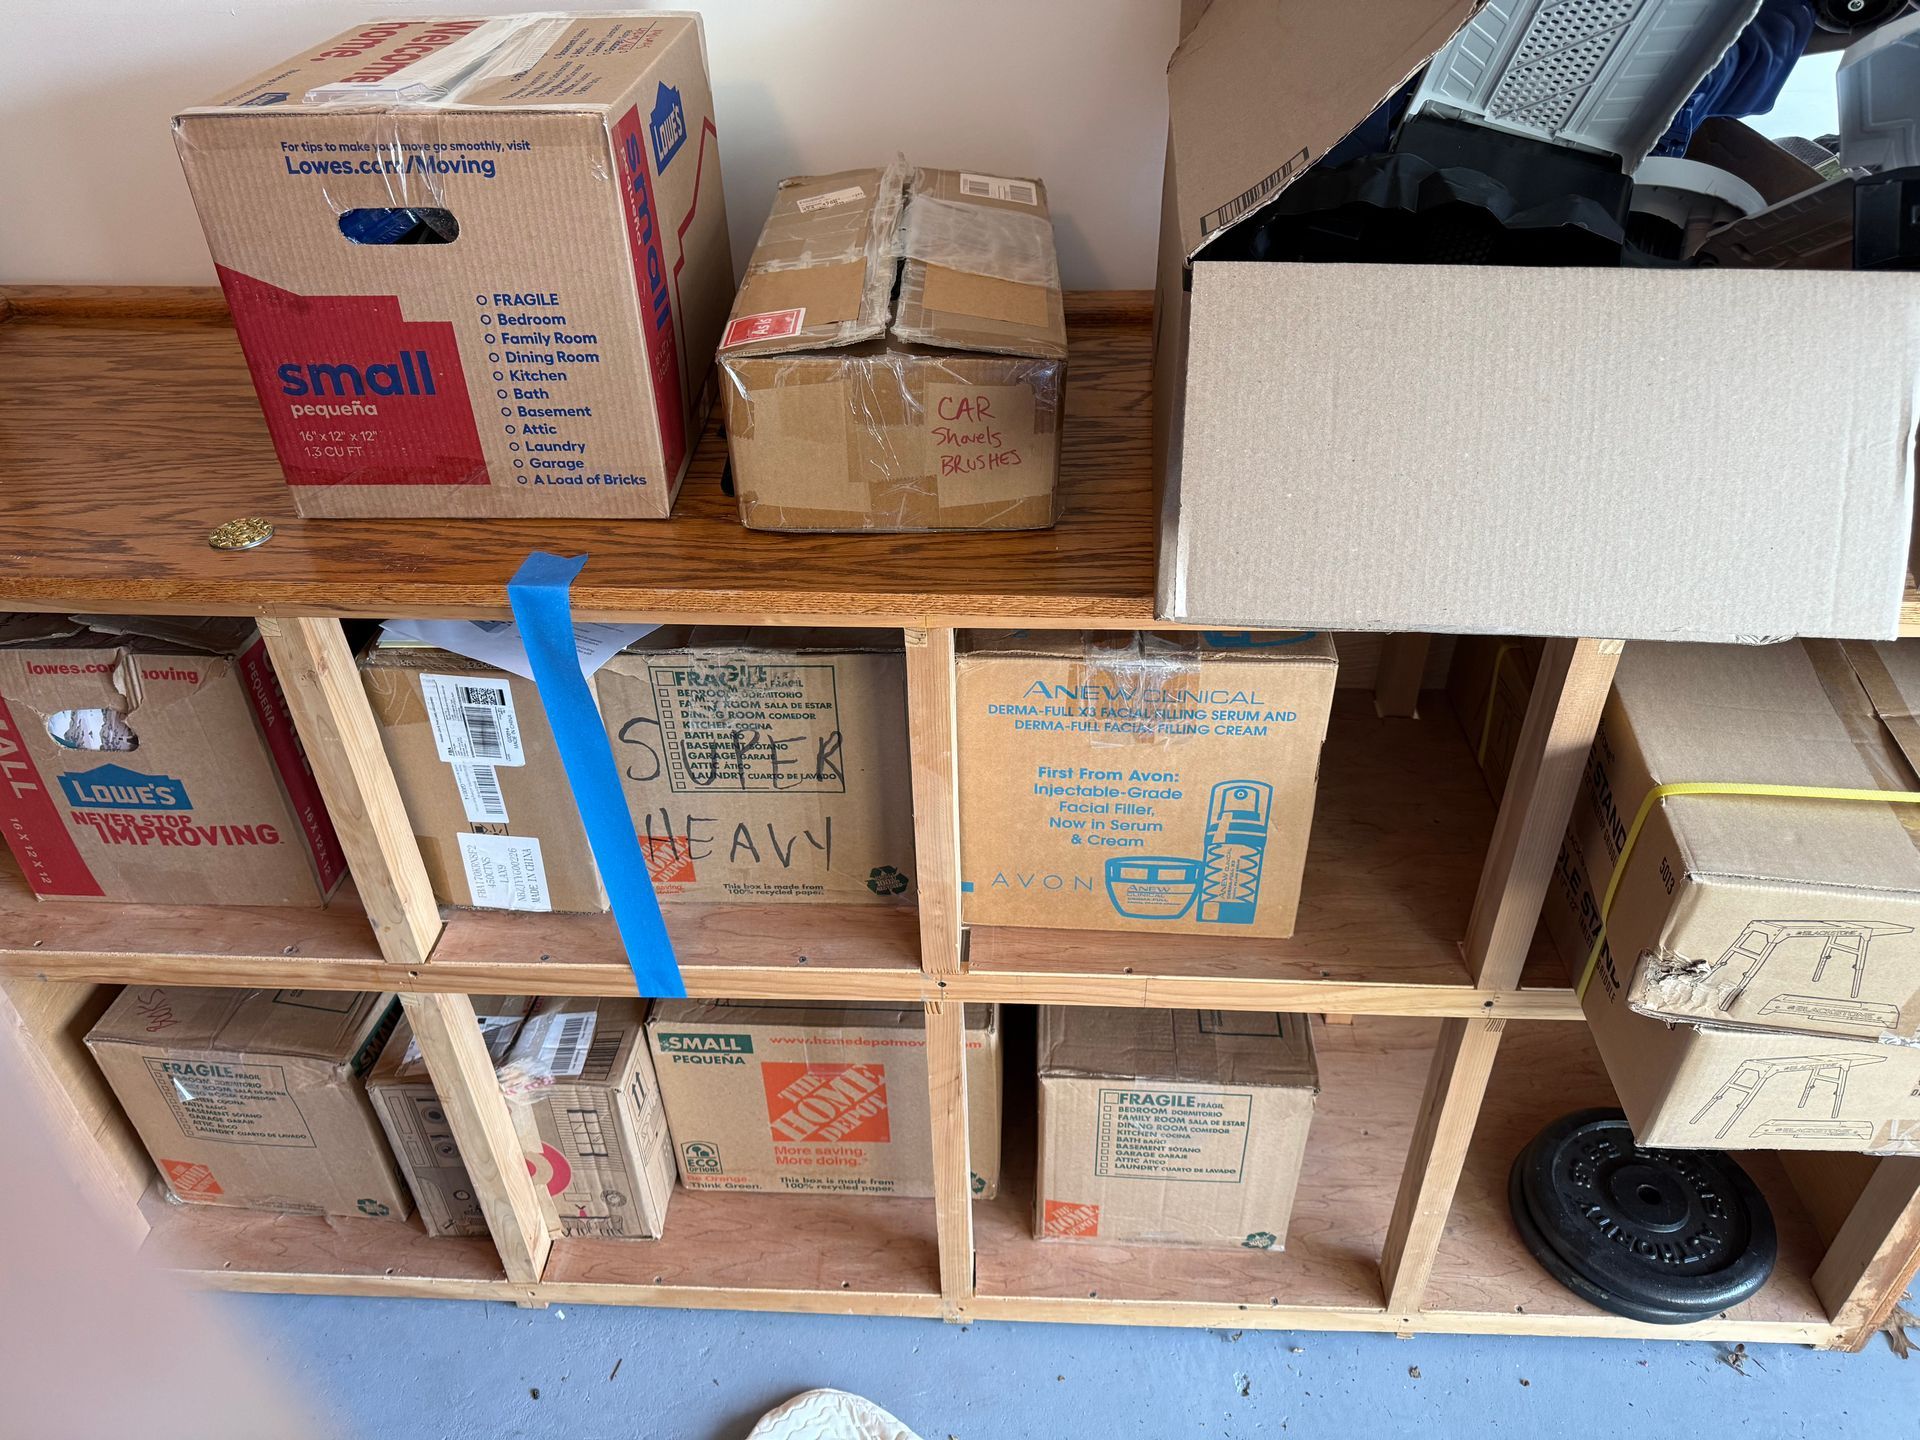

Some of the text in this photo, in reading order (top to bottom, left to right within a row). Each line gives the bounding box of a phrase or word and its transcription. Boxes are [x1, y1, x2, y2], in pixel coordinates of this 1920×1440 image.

[340, 20, 489, 82] Welcome
[656, 104, 682, 161] LOWE'S
[280, 140, 530, 154] For tips to make your move go smoothly, visit
[285, 155, 495, 178] Lowes.com/Moving
[493, 293, 559, 306] FRAGILE
[498, 313, 566, 326] Bedroom
[501, 332, 598, 347] Family Room
[505, 351, 600, 365] Dining Room
[278, 351, 436, 396] small
[509, 369, 567, 382] Kitchen
[513, 388, 549, 400] Bath
[291, 400, 378, 419] pequeña
[517, 406, 592, 417] Basement
[937, 396, 996, 421] CAR
[522, 423, 558, 435] Attic
[299, 431, 378, 442] 16" x 12" x 12"
[304, 446, 362, 457] 1.3 CU FT
[525, 441, 586, 454] Laundry
[529, 457, 585, 471] Garage
[940, 449, 1022, 476] BRUSHES
[534, 474, 647, 485] A Load of Bricks
[1143, 689, 1266, 706] CLINICAL
[728, 711, 765, 720] ROOM
[988, 704, 1074, 717] DERMA-FULL
[1079, 707, 1096, 717] X3
[1101, 707, 1151, 719] FACIAL
[1211, 710, 1260, 722] SERUM
[1264, 711, 1297, 722] AND
[736, 722, 773, 730] COCINA
[1014, 720, 1268, 737] DERMA-FULL FACIAL FILLING CREAM
[685, 731, 714, 739] BATH
[687, 742, 746, 750] BASEMENT
[618, 717, 843, 790] SUPER
[688, 752, 736, 760] GARAGE
[691, 761, 720, 770] ATTIC
[692, 772, 744, 780] LAUNDRY
[1038, 766, 1180, 783] First From Avon:
[72, 780, 177, 805] LOWE'S
[1034, 783, 1183, 800] Injectable-Grade
[1059, 801, 1156, 817] Facial Filler,
[70, 811, 192, 828] NEVER STOP
[1049, 817, 1163, 832] Now in Serum
[645, 807, 832, 871] HEAVY
[1071, 834, 1144, 847] & Cream
[991, 871, 1093, 892] AVON
[1659, 857, 1675, 895] 5013
[668, 1037, 742, 1051] SMALL
[673, 1053, 746, 1065] PEQUEÑA
[162, 1063, 234, 1078] FRAGILE
[777, 1071, 830, 1103] THE
[770, 1064, 887, 1141] HOME
[1120, 1093, 1196, 1108] FRAGILE
[818, 1093, 888, 1142] DEPOT
[1117, 1130, 1158, 1138] KITCHEN
[1156, 1124, 1188, 1132] ROOM
[774, 1146, 867, 1157] More saving.
[1116, 1143, 1165, 1151] BASEMENT
[687, 1159, 718, 1168] ECO
[776, 1156, 862, 1167] More doing.
[1114, 1163, 1159, 1172] LAUNDRY
